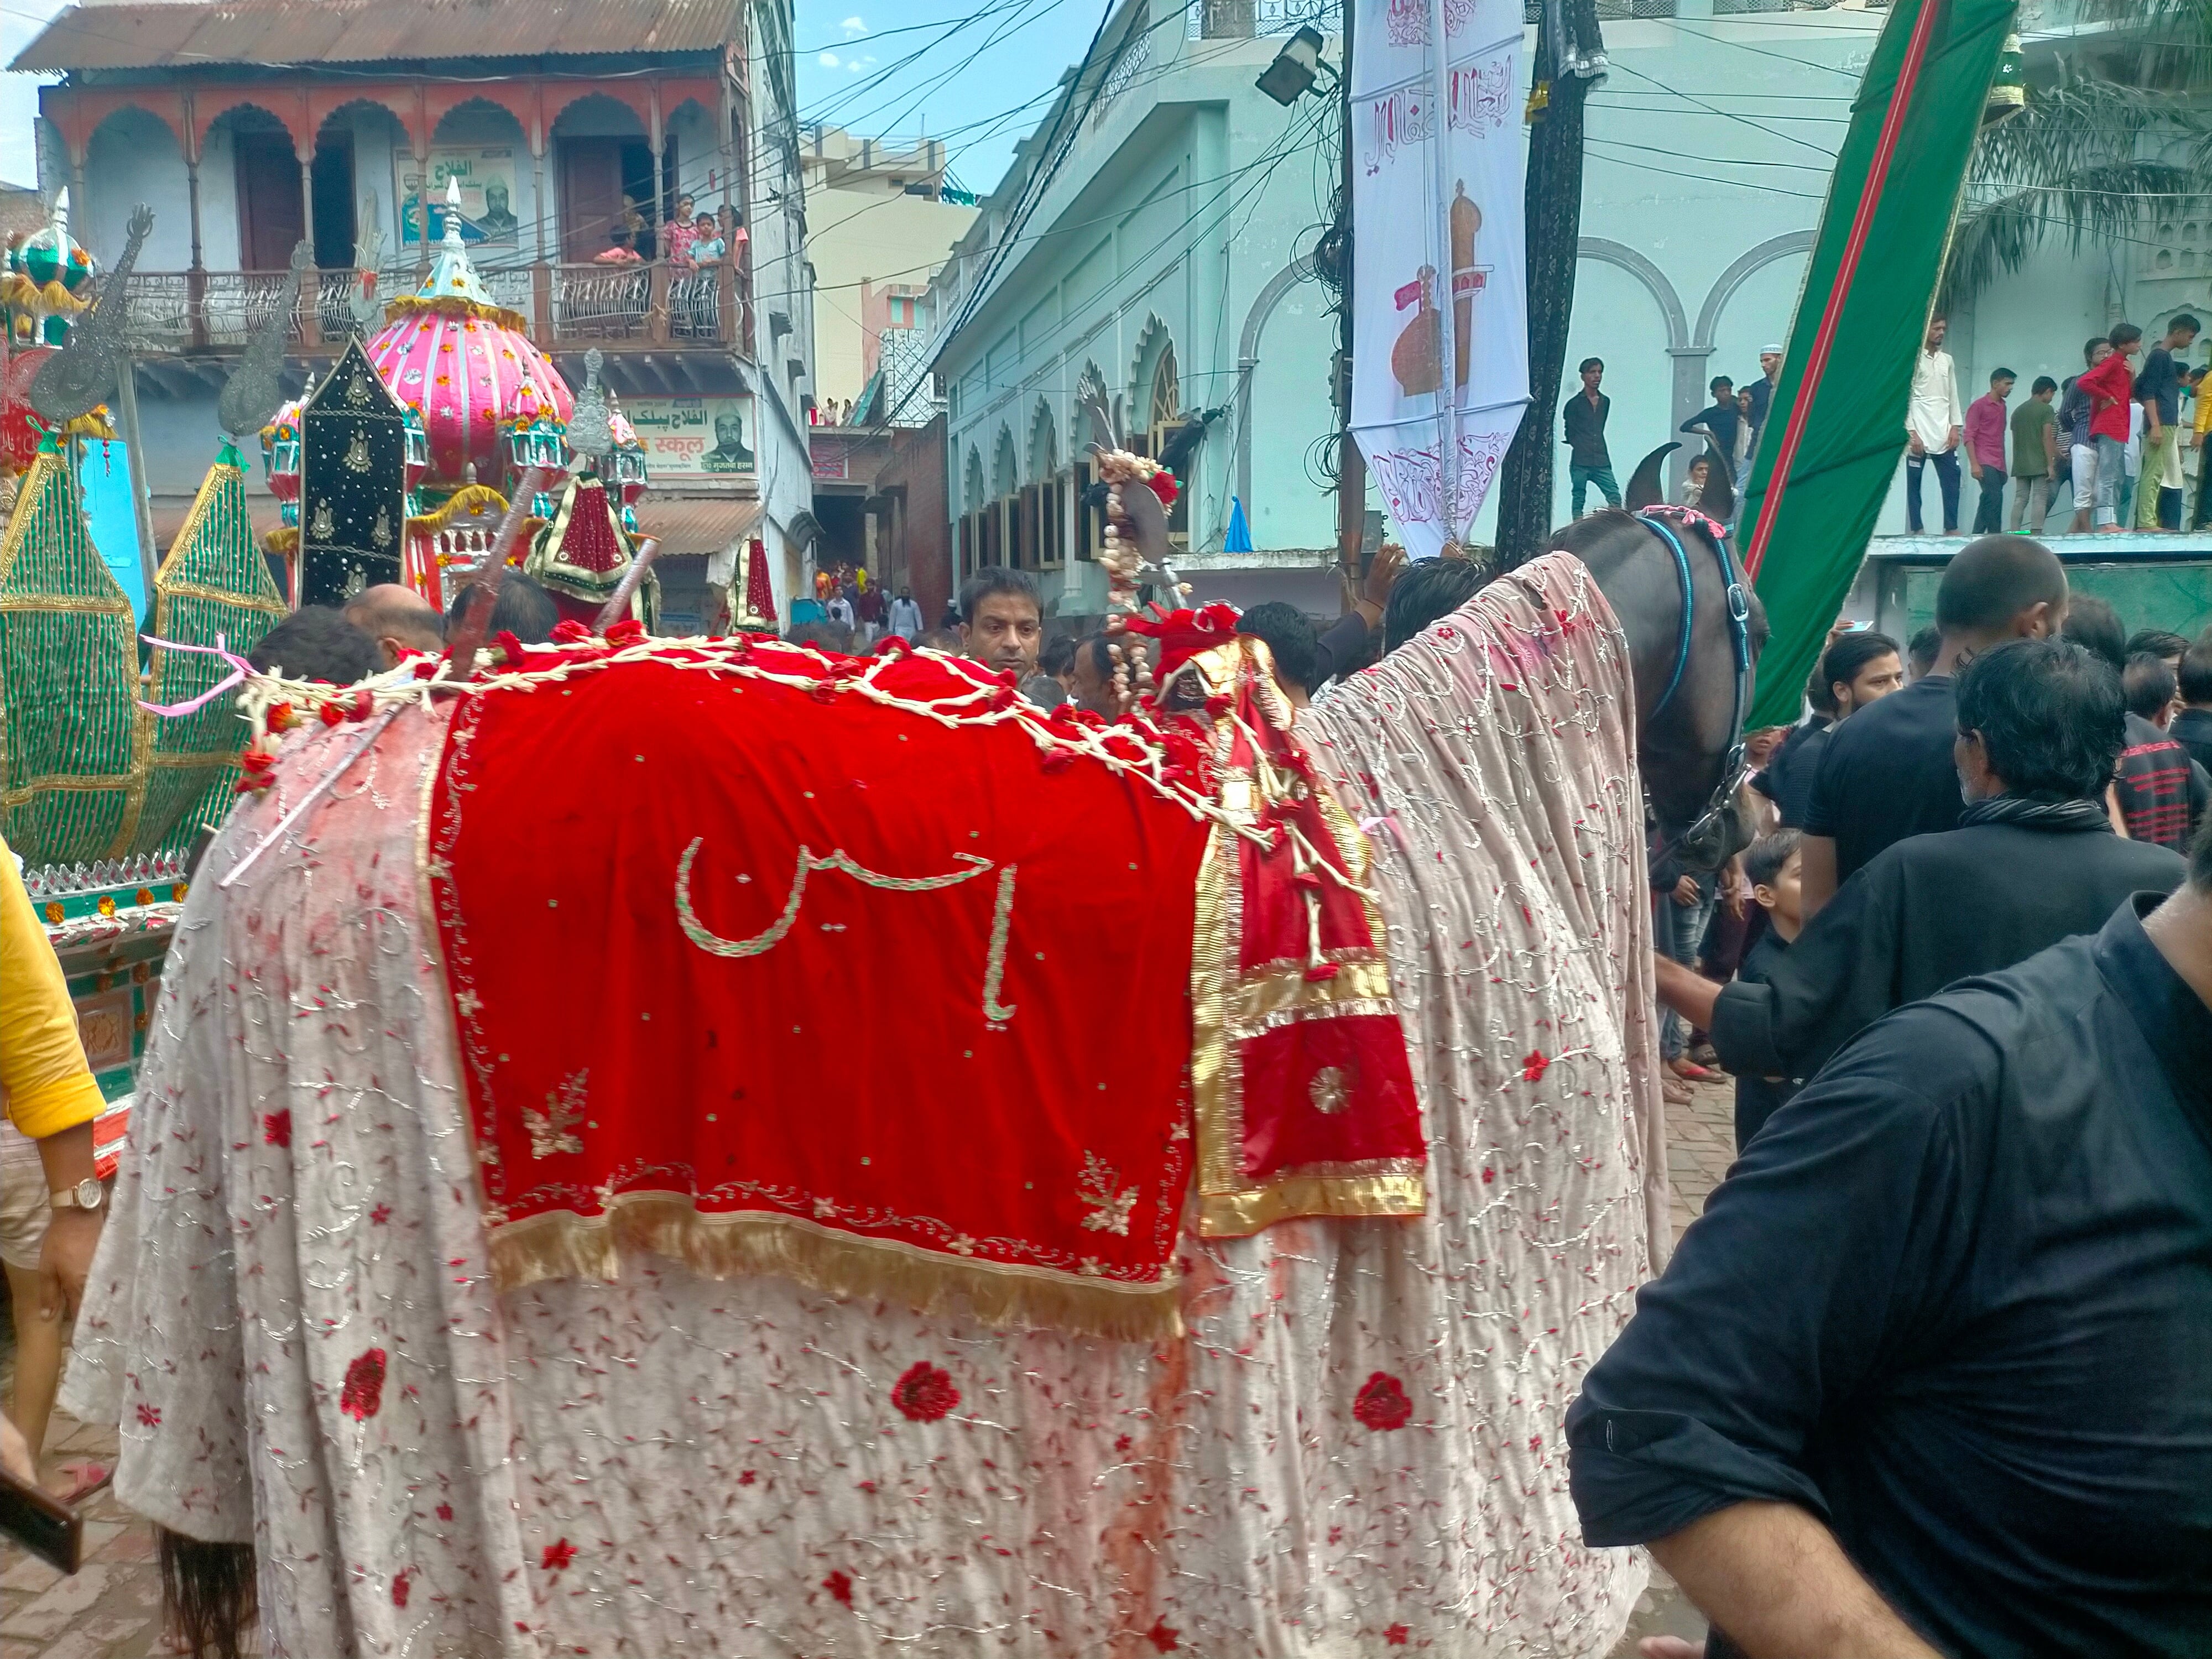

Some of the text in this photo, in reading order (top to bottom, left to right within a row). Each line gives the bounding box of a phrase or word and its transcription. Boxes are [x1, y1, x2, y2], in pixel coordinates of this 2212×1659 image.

[434, 159, 472, 181] الفلاح
[632, 409, 670, 432] پبلک
[672, 409, 708, 429] الفلاح
[655, 437, 705, 461] स्कूल
